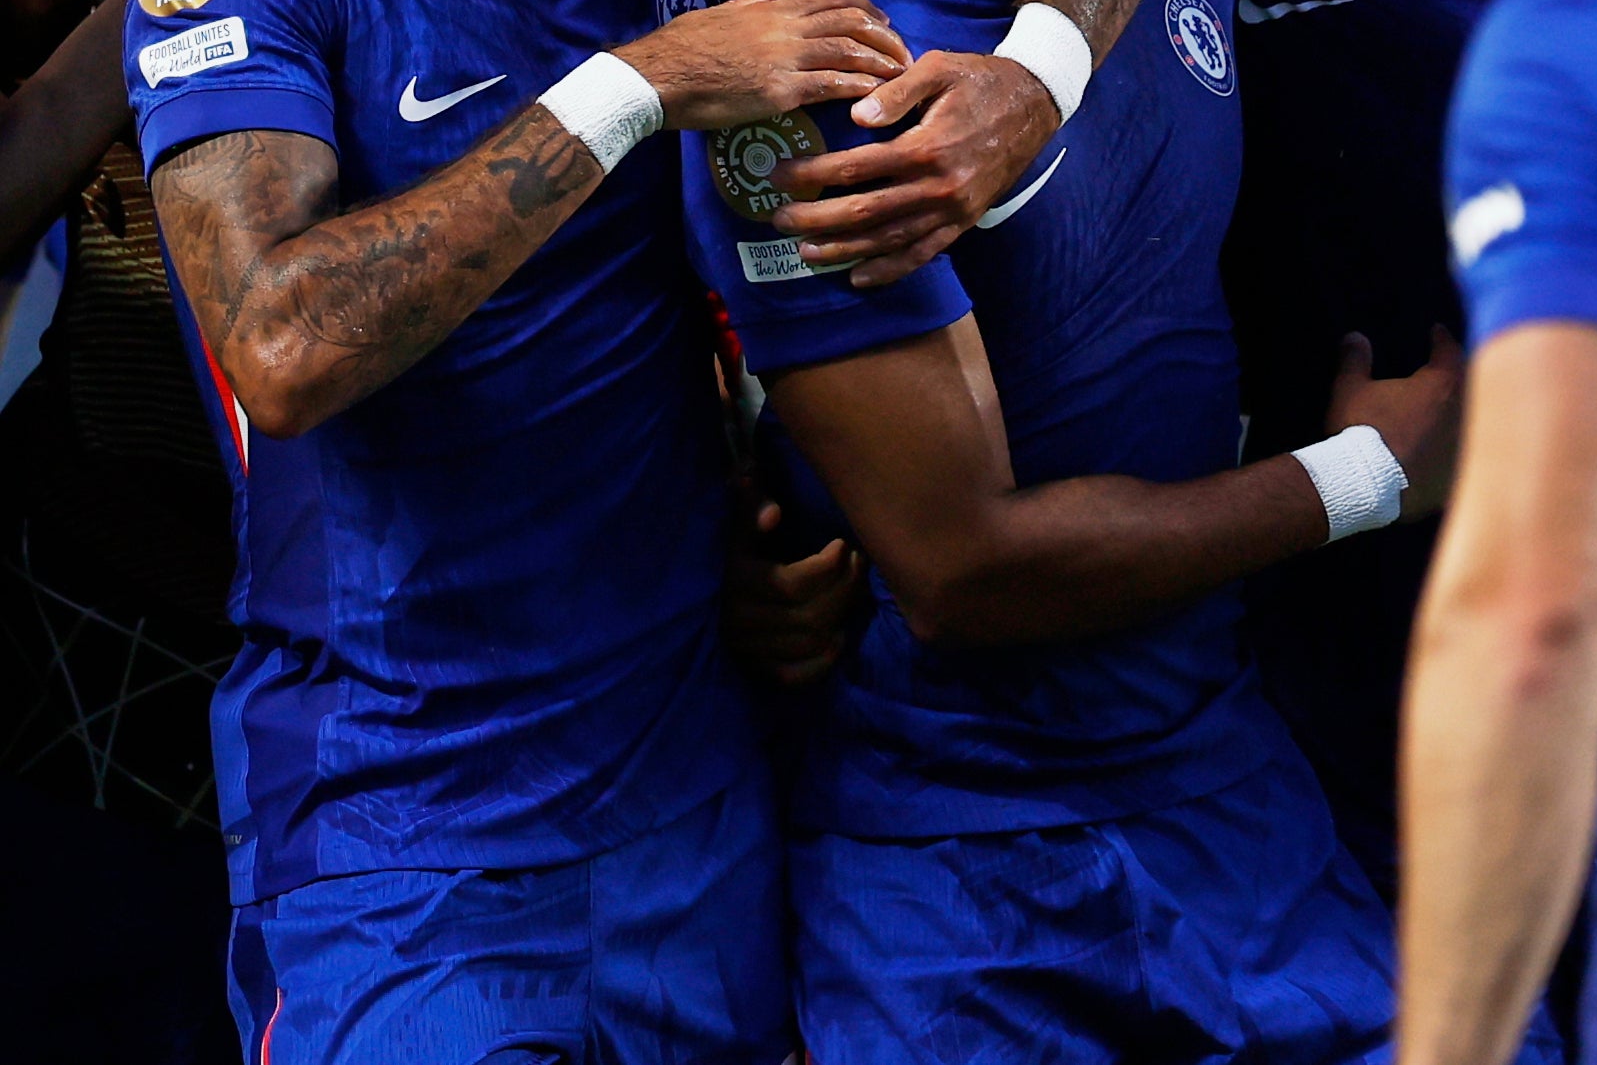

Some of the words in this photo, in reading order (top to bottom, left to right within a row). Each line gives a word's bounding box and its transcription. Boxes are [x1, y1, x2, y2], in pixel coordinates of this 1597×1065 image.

[149, 36, 192, 61] FOOTBALL
[194, 24, 231, 45] UNITES
[206, 43, 233, 60] FIFA
[716, 156, 740, 196] CLUB
[792, 129, 811, 150] 25
[752, 260, 775, 277] the
